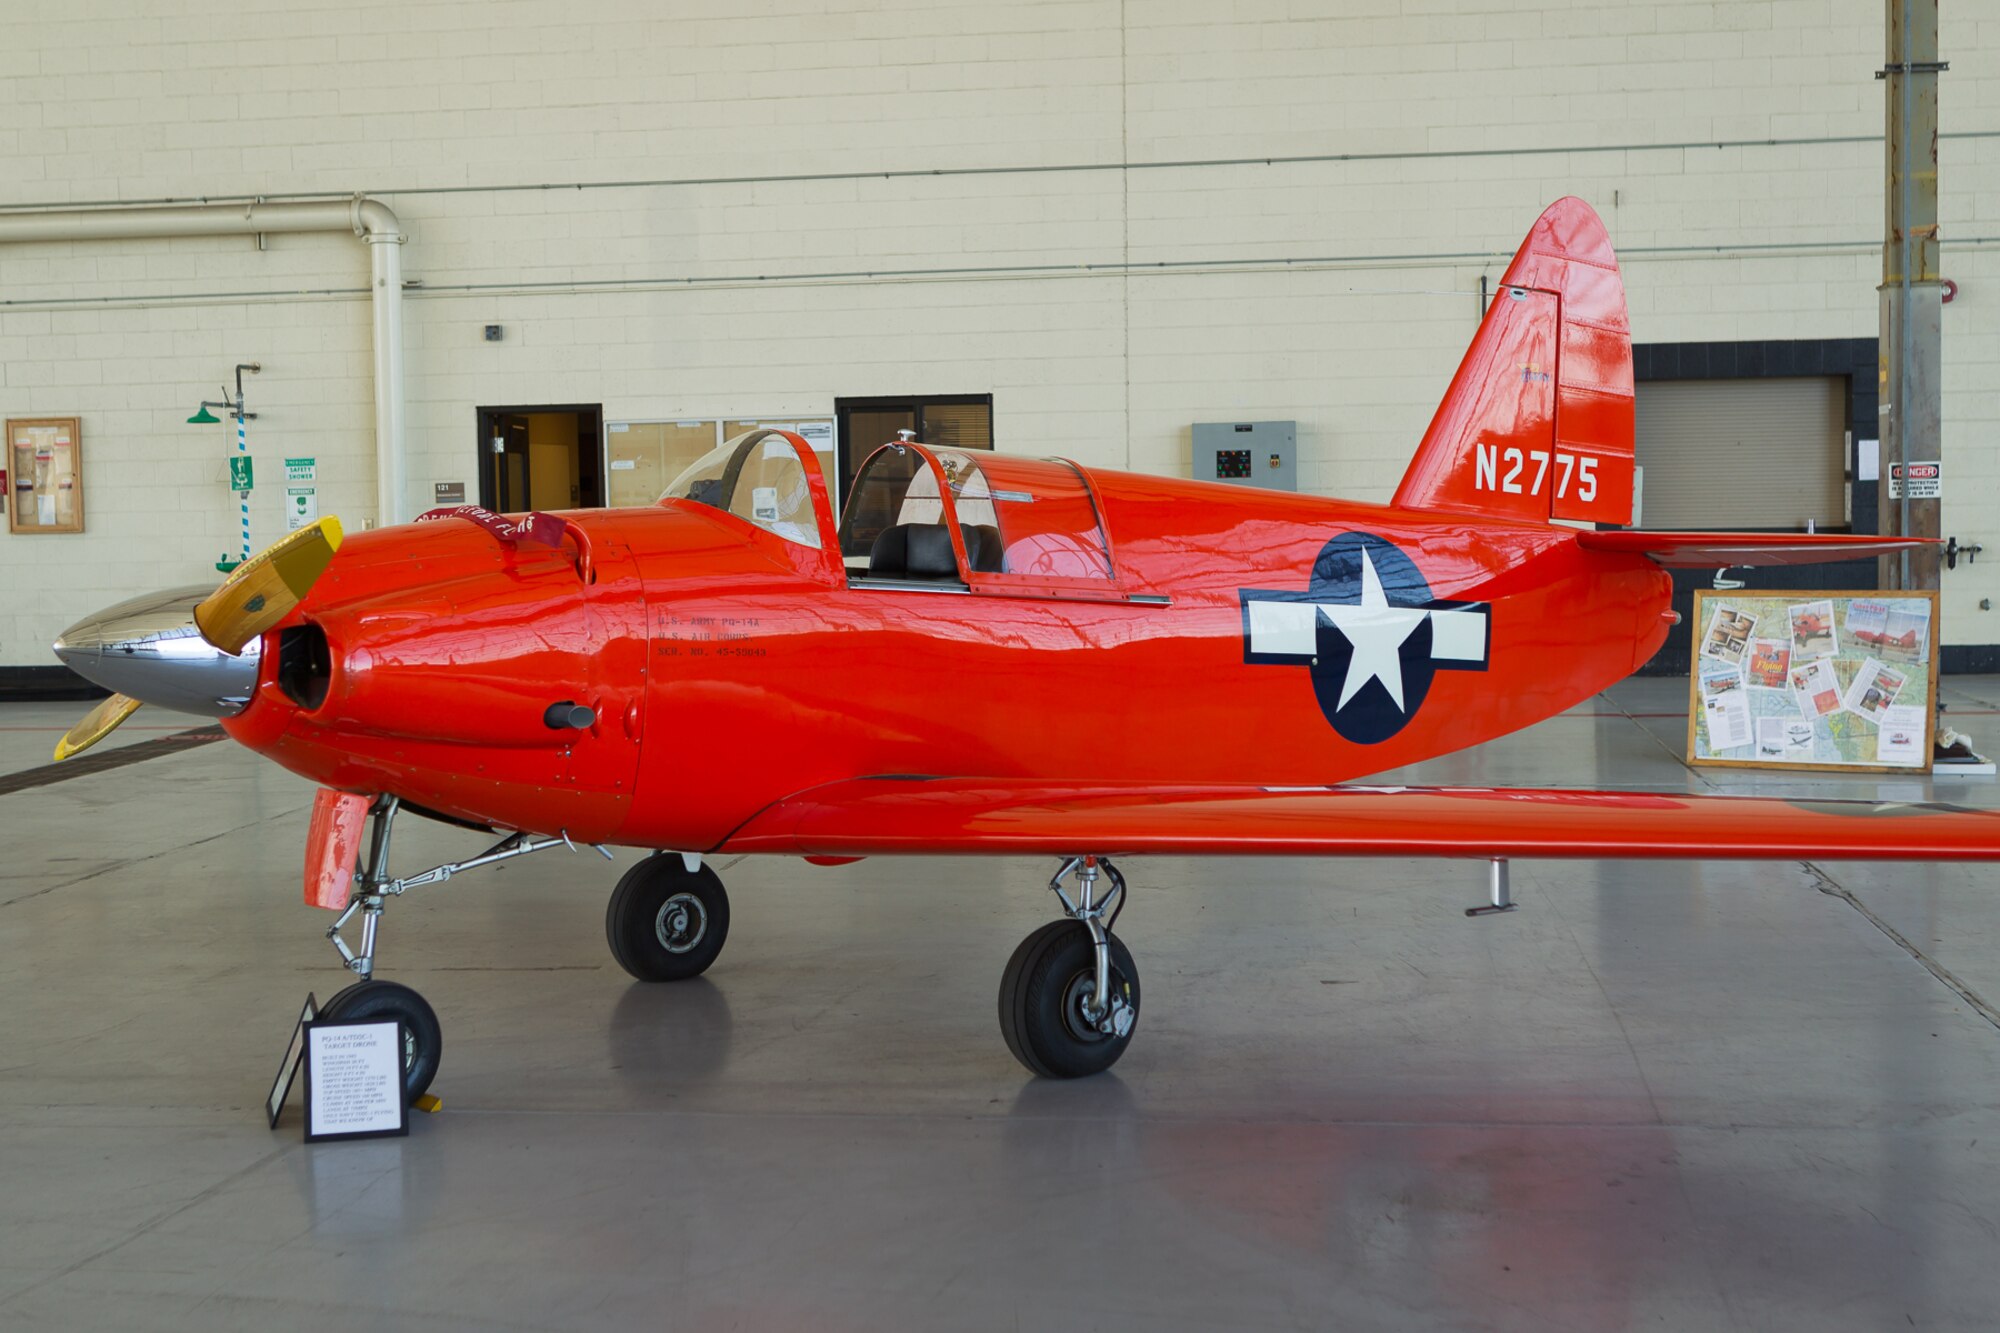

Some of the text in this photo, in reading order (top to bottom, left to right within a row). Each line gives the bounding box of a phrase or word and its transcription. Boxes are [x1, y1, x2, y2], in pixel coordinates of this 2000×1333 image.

[1476, 443, 1598, 502] N2775
[690, 617, 715, 625] ARMY
[721, 617, 760, 627] PQ-14A
[691, 632, 711, 641] AIR
